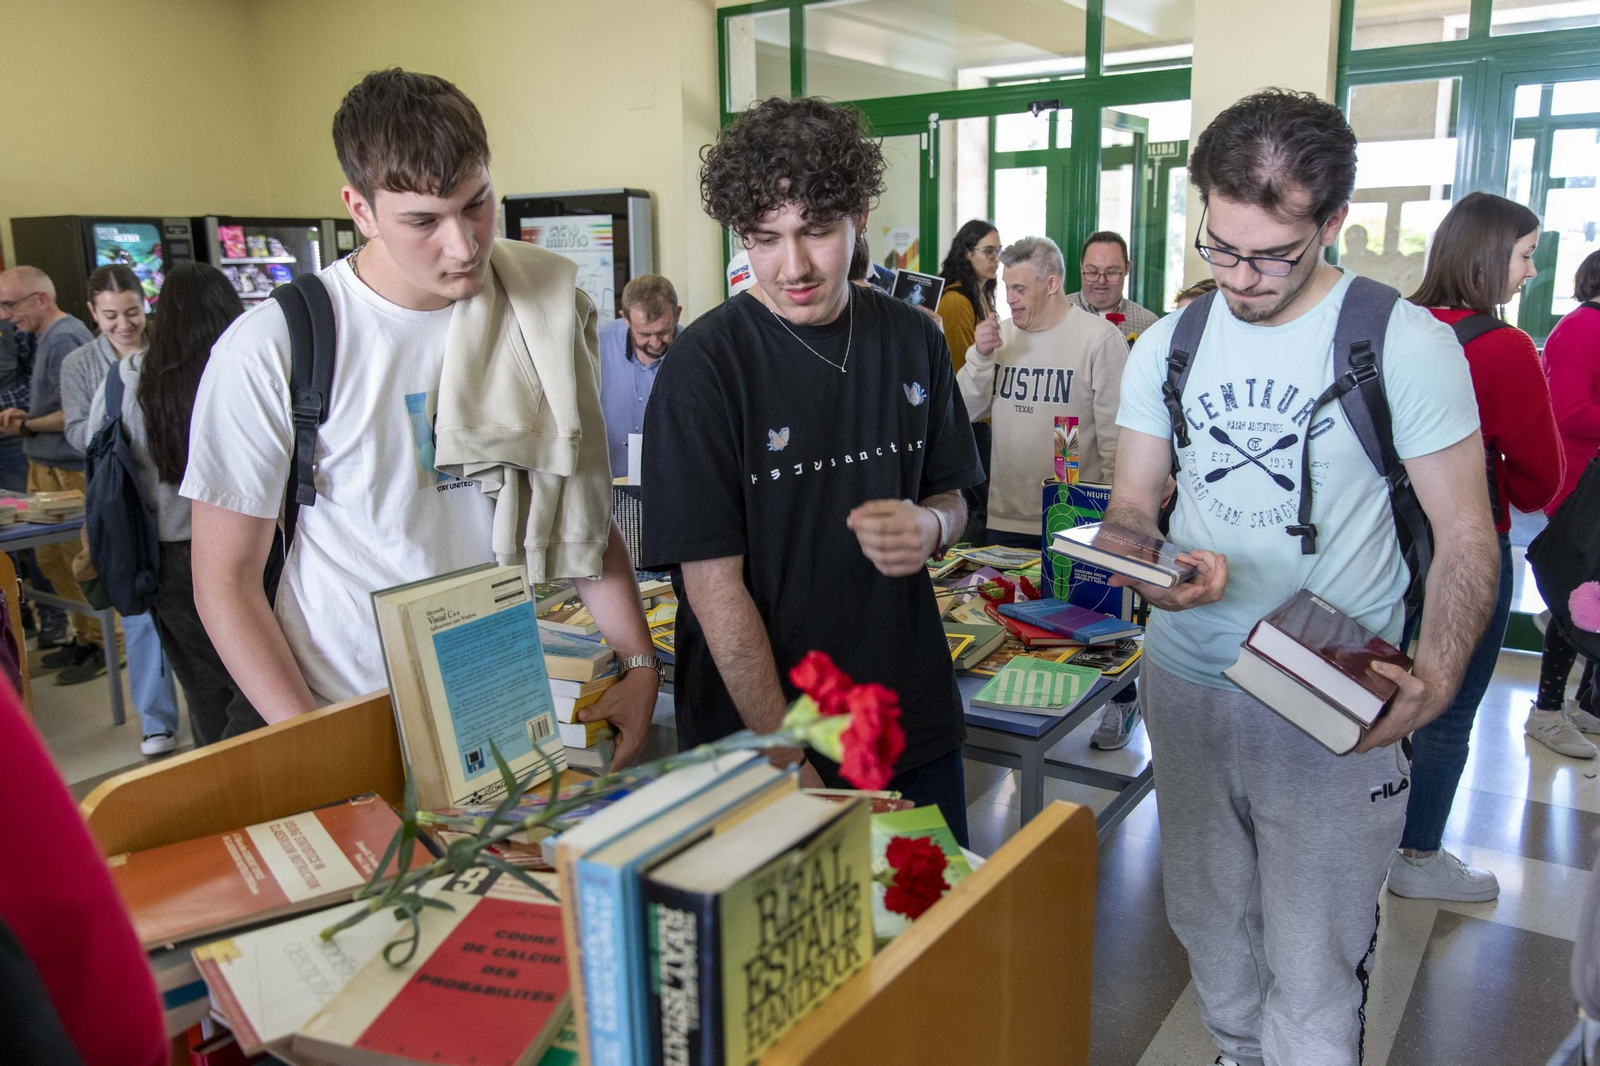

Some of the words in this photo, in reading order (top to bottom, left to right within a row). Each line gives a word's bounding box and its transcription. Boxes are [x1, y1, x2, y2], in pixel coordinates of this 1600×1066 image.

[730, 264, 748, 278] PEPSI
[1014, 404, 1034, 414] TEXAS
[436, 484, 449, 493] STAY
[449, 482, 474, 490] UNITED
[428, 612, 447, 625] Visual
[448, 610, 460, 619] C++
[1370, 778, 1409, 802] FILA
[756, 840, 852, 951] REAL
[494, 929, 557, 945] COURS
[462, 942, 487, 954] DE
[492, 948, 562, 964] CALCUL
[742, 884, 860, 1013] ESTATE
[480, 965, 520, 979] DES
[417, 974, 557, 1002] PROBABILITÉS
[744, 928, 862, 1054] HANDBOOK
